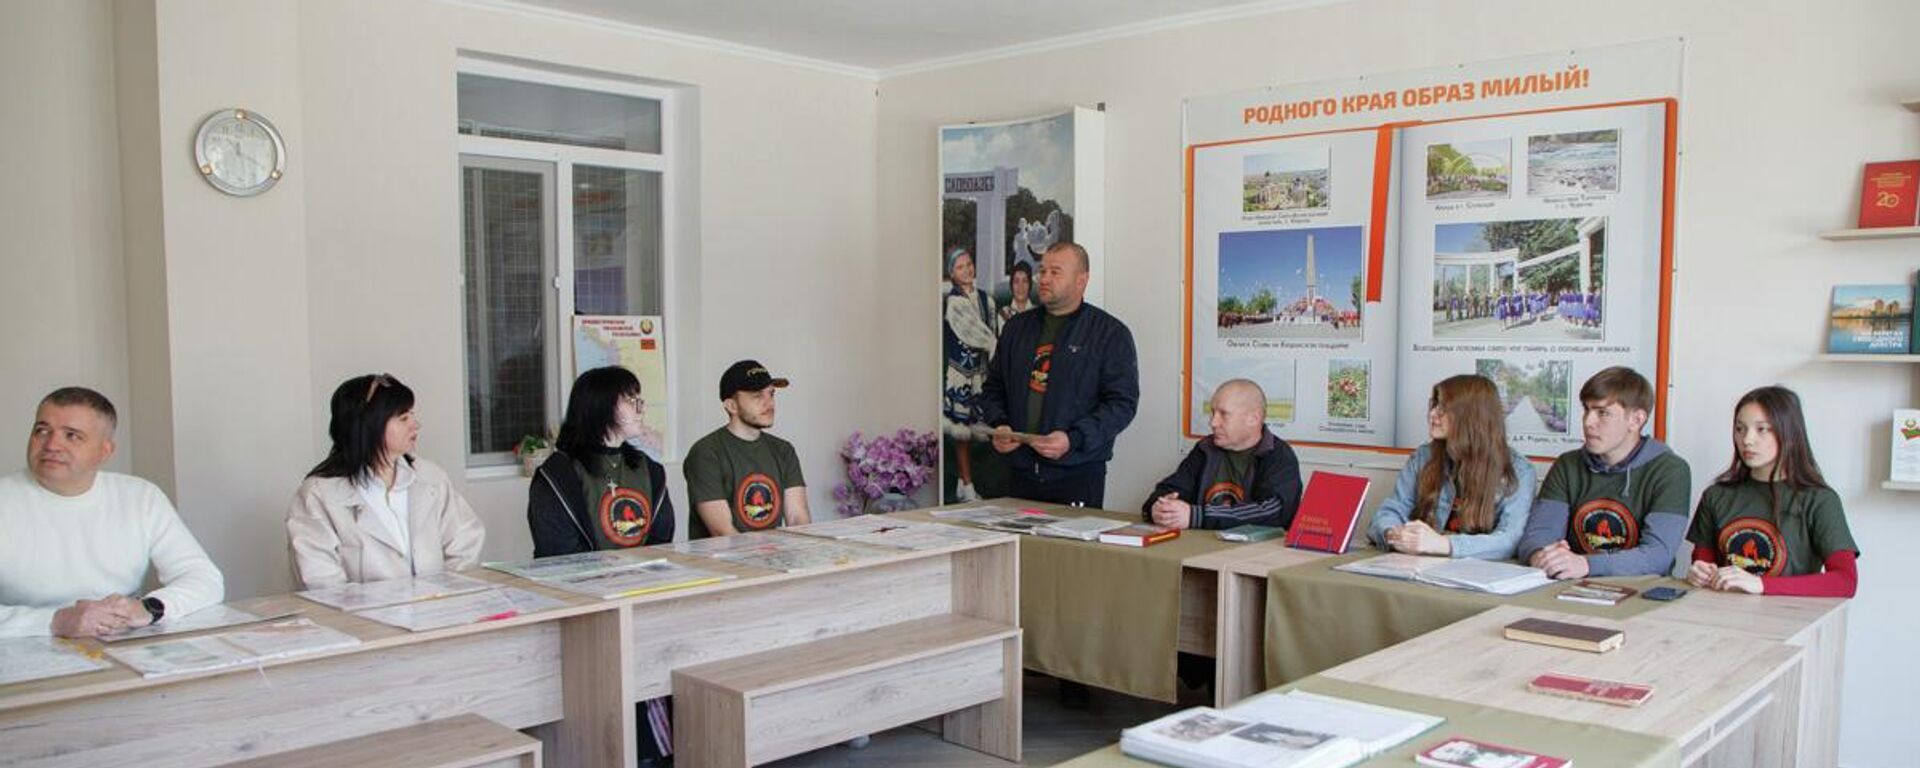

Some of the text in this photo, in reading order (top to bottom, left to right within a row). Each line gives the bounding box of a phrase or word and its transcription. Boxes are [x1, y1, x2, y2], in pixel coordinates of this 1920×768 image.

[1243, 64, 1590, 125] РОДНОГО КРАЯ ОБРАЗ МИЛЫЙ!
